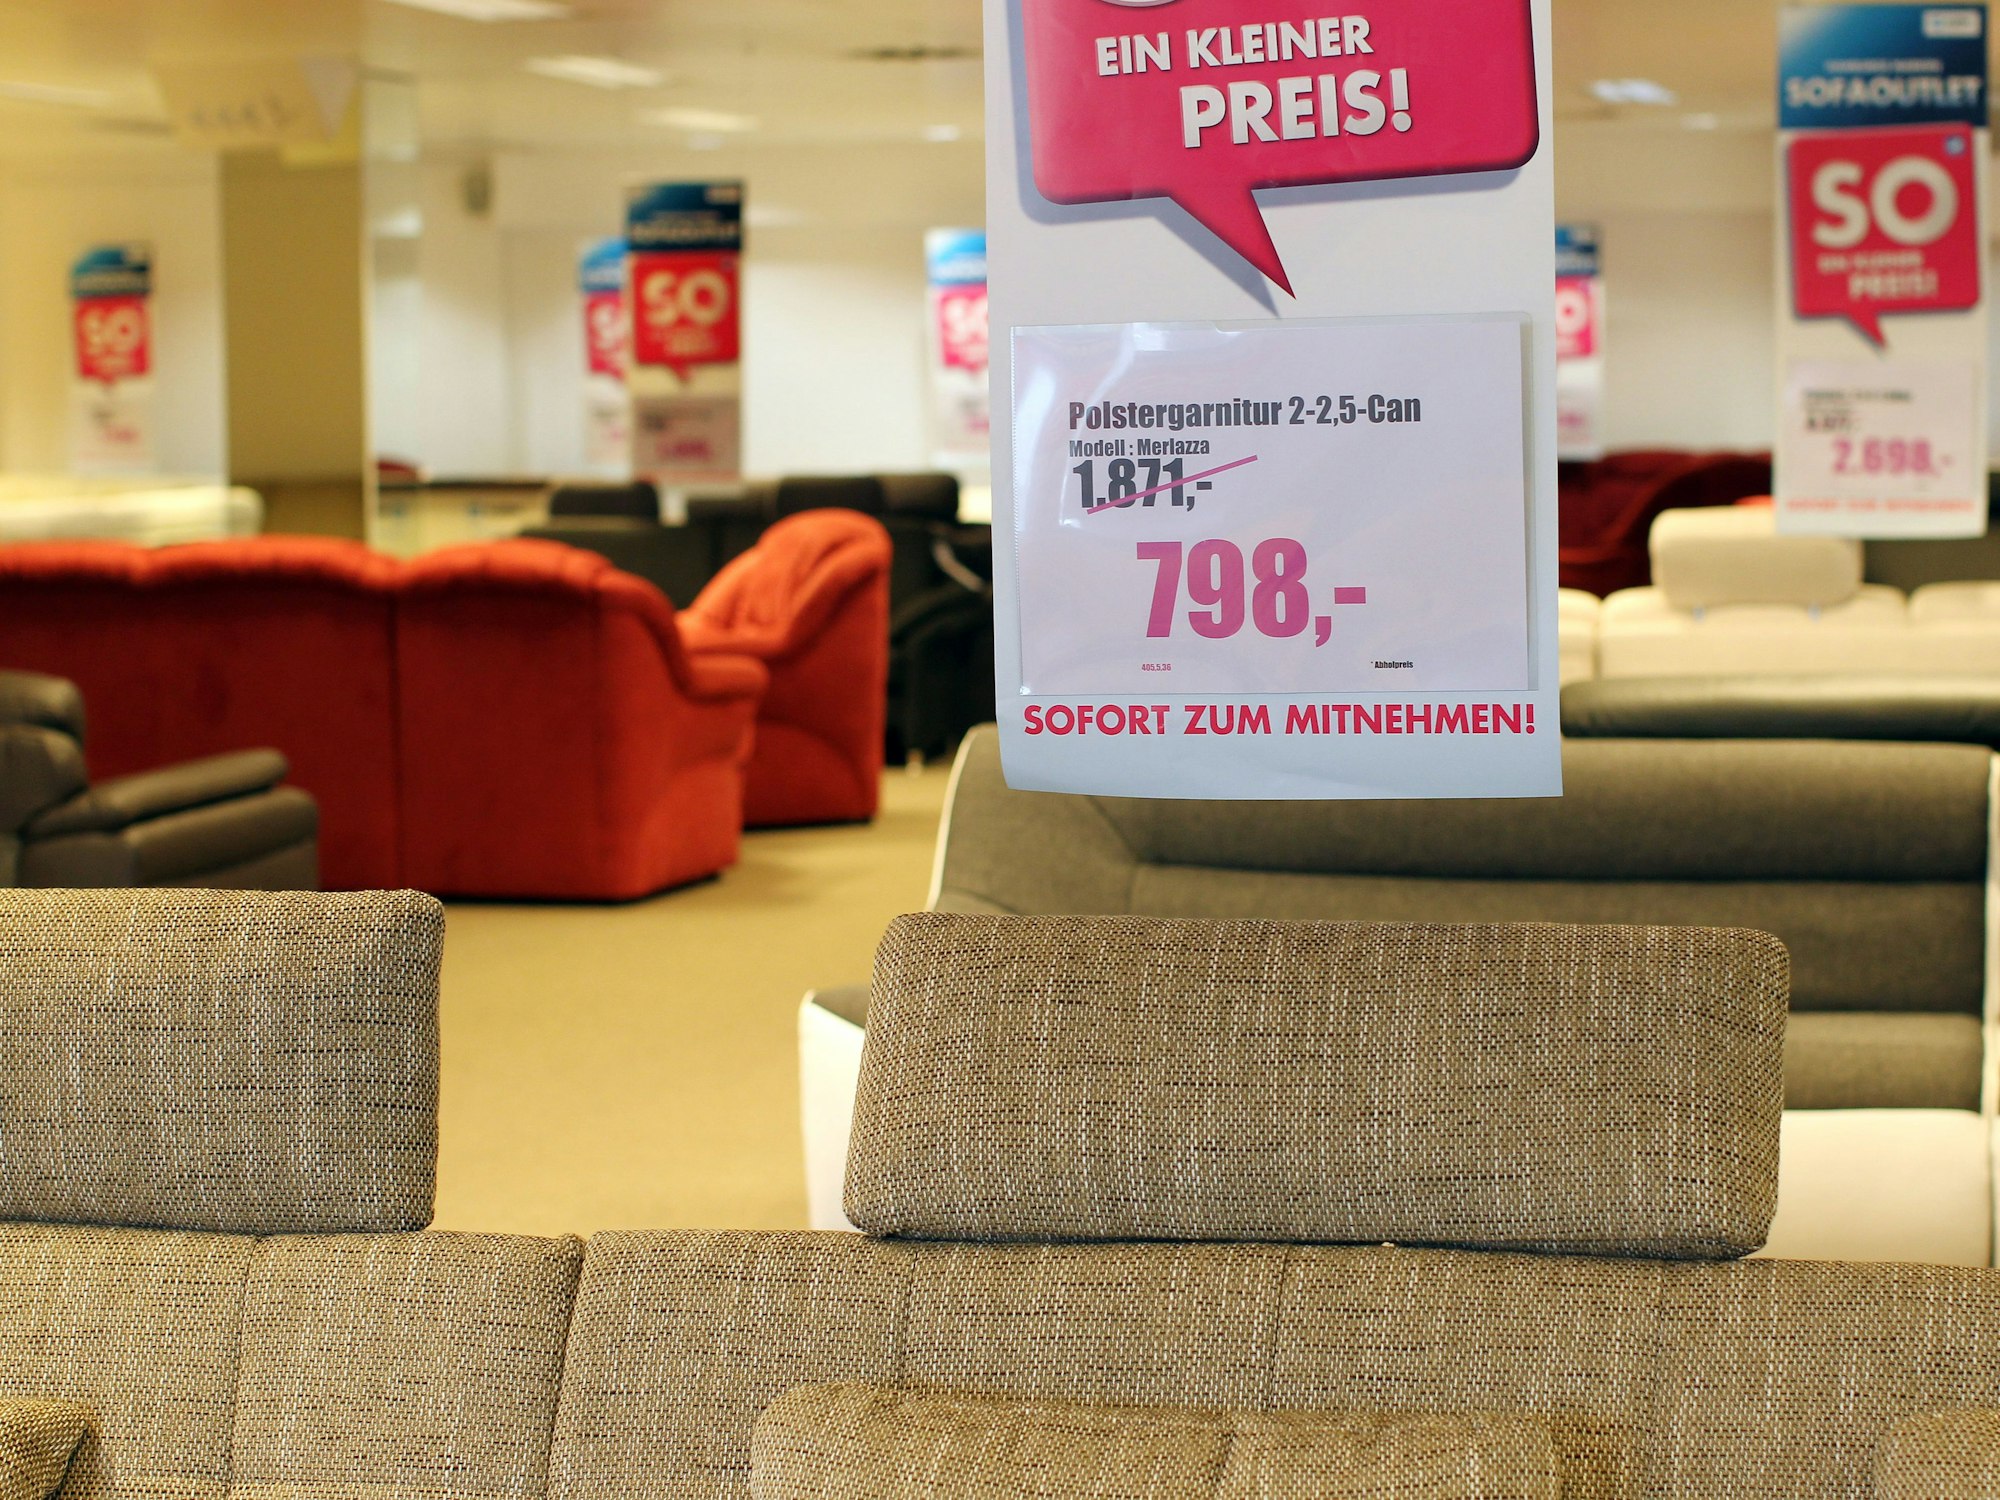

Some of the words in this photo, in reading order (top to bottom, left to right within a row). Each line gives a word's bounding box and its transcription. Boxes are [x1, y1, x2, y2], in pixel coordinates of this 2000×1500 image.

[1096, 33, 1172, 76] EIN
[1187, 15, 1373, 68] KLEINER
[1179, 68, 1413, 148] PREIS!
[1786, 76, 1981, 108] SOFAOUTLET
[1811, 156, 1959, 248] SO
[643, 270, 730, 327] SO
[1069, 398, 1282, 431] Polstergarnitur
[1288, 394, 1421, 427] 2-2,5-Can
[1069, 439, 1125, 457] Modell
[1137, 438, 1210, 456] Merlazza
[1073, 457, 1212, 512] 1.871,-
[1136, 537, 1366, 647] 798,-
[1024, 704, 1171, 736] SOFORT
[1184, 705, 1272, 735] ZUM
[1285, 703, 1536, 735] MITNEHMEN!
